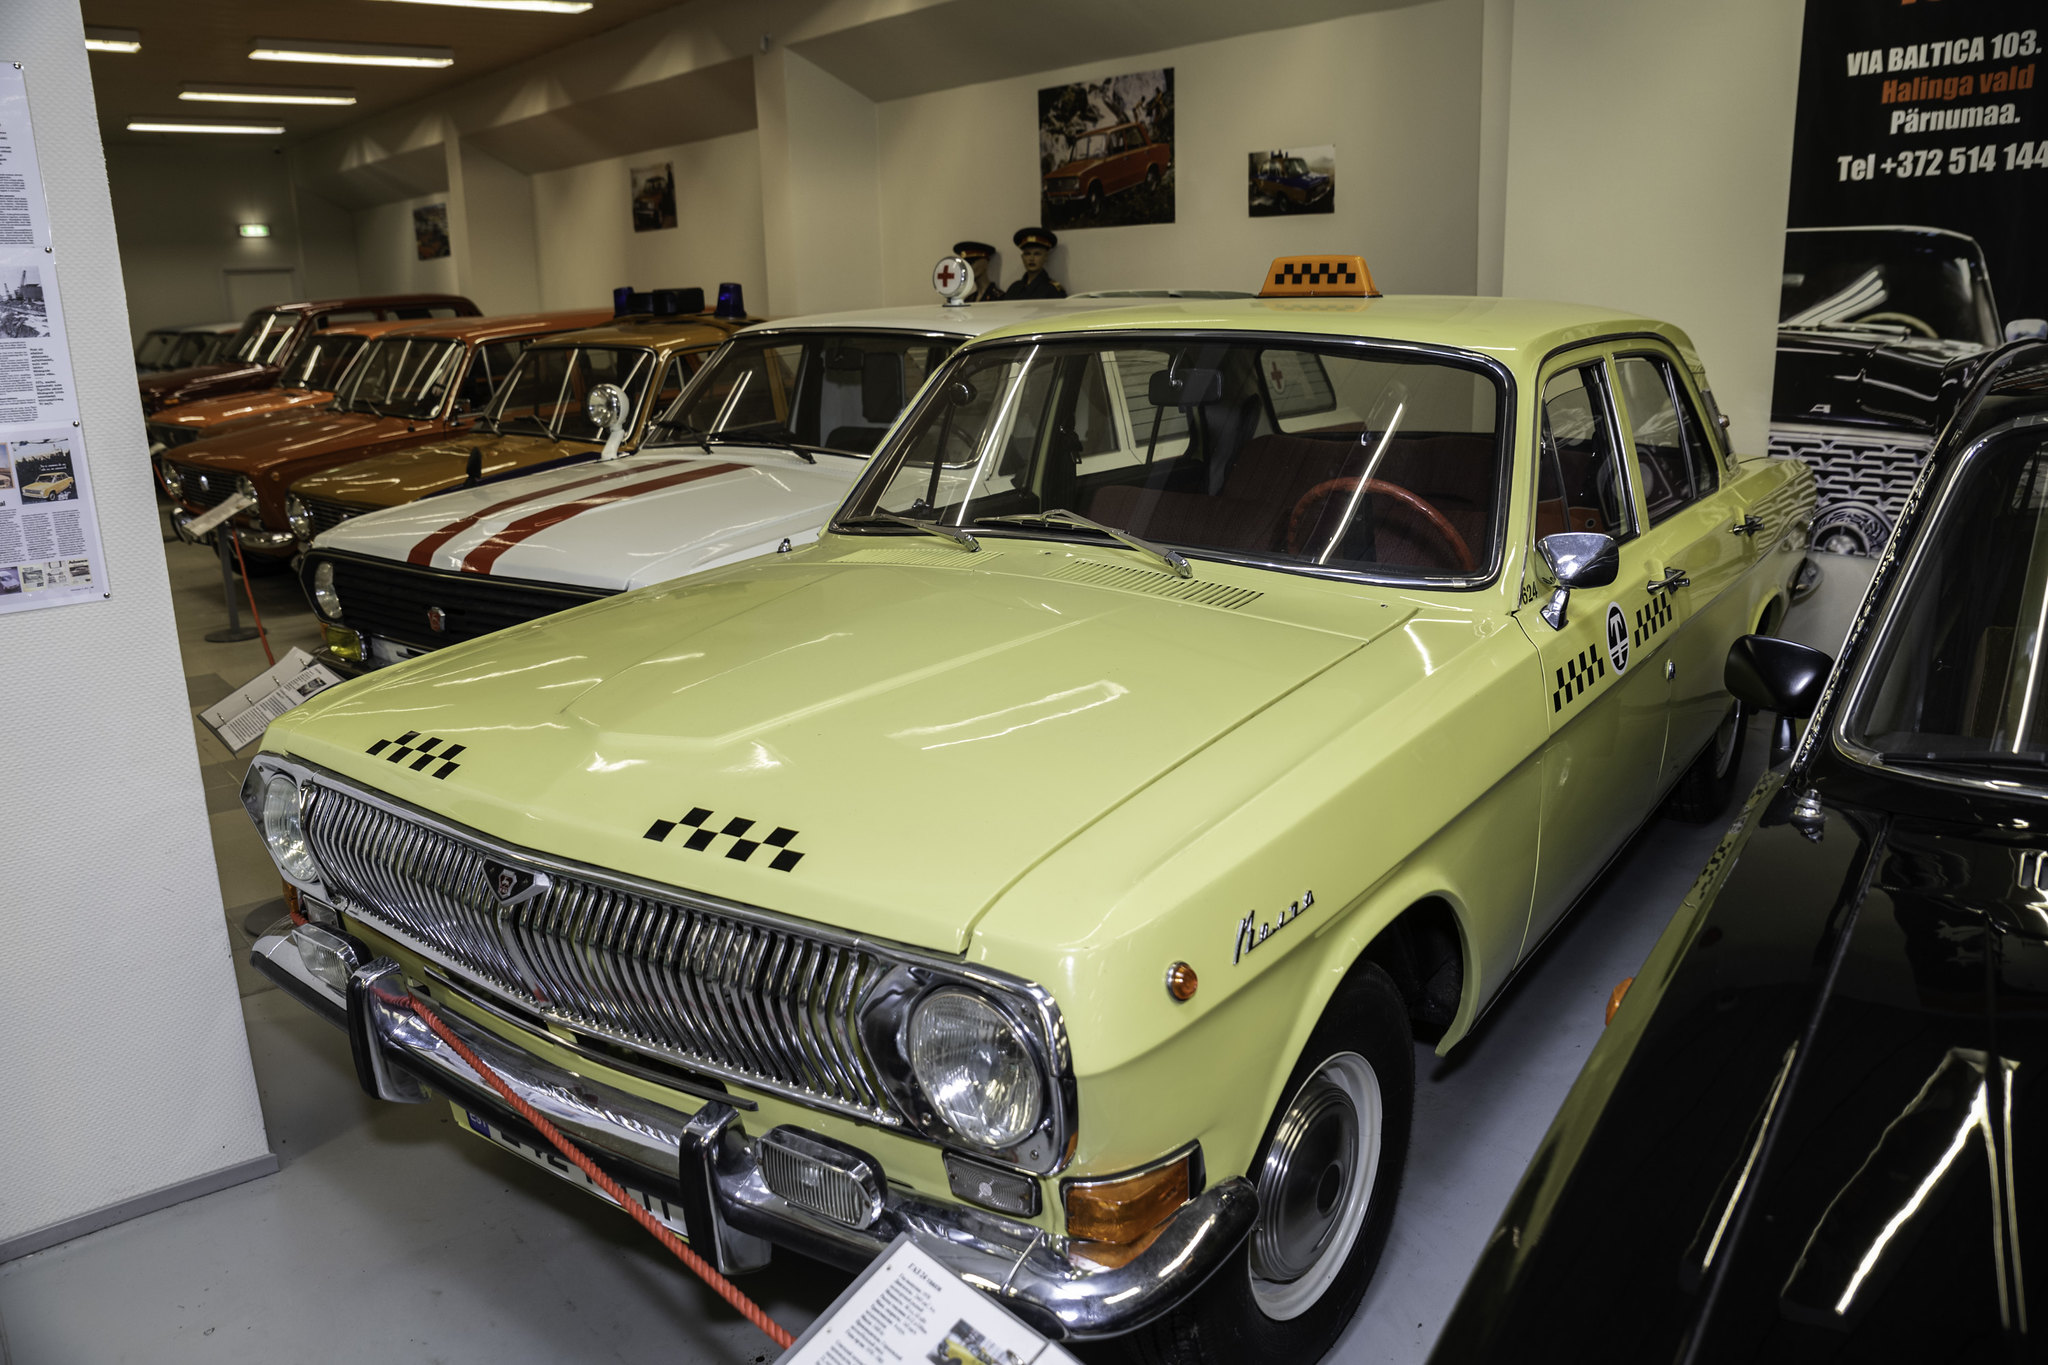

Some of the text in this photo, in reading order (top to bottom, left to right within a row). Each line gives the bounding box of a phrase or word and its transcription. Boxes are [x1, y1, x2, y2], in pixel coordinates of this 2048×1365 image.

[1847, 29, 2042, 77] VIA BALTICA 103.
[1881, 63, 2036, 104] Halinga vald
[1889, 103, 2021, 135] Pärnumaa.
[1837, 153, 1876, 181] Tel
[1880, 148, 1944, 179] +372
[1948, 144, 1997, 175] 514
[1522, 581, 1538, 605] 624
